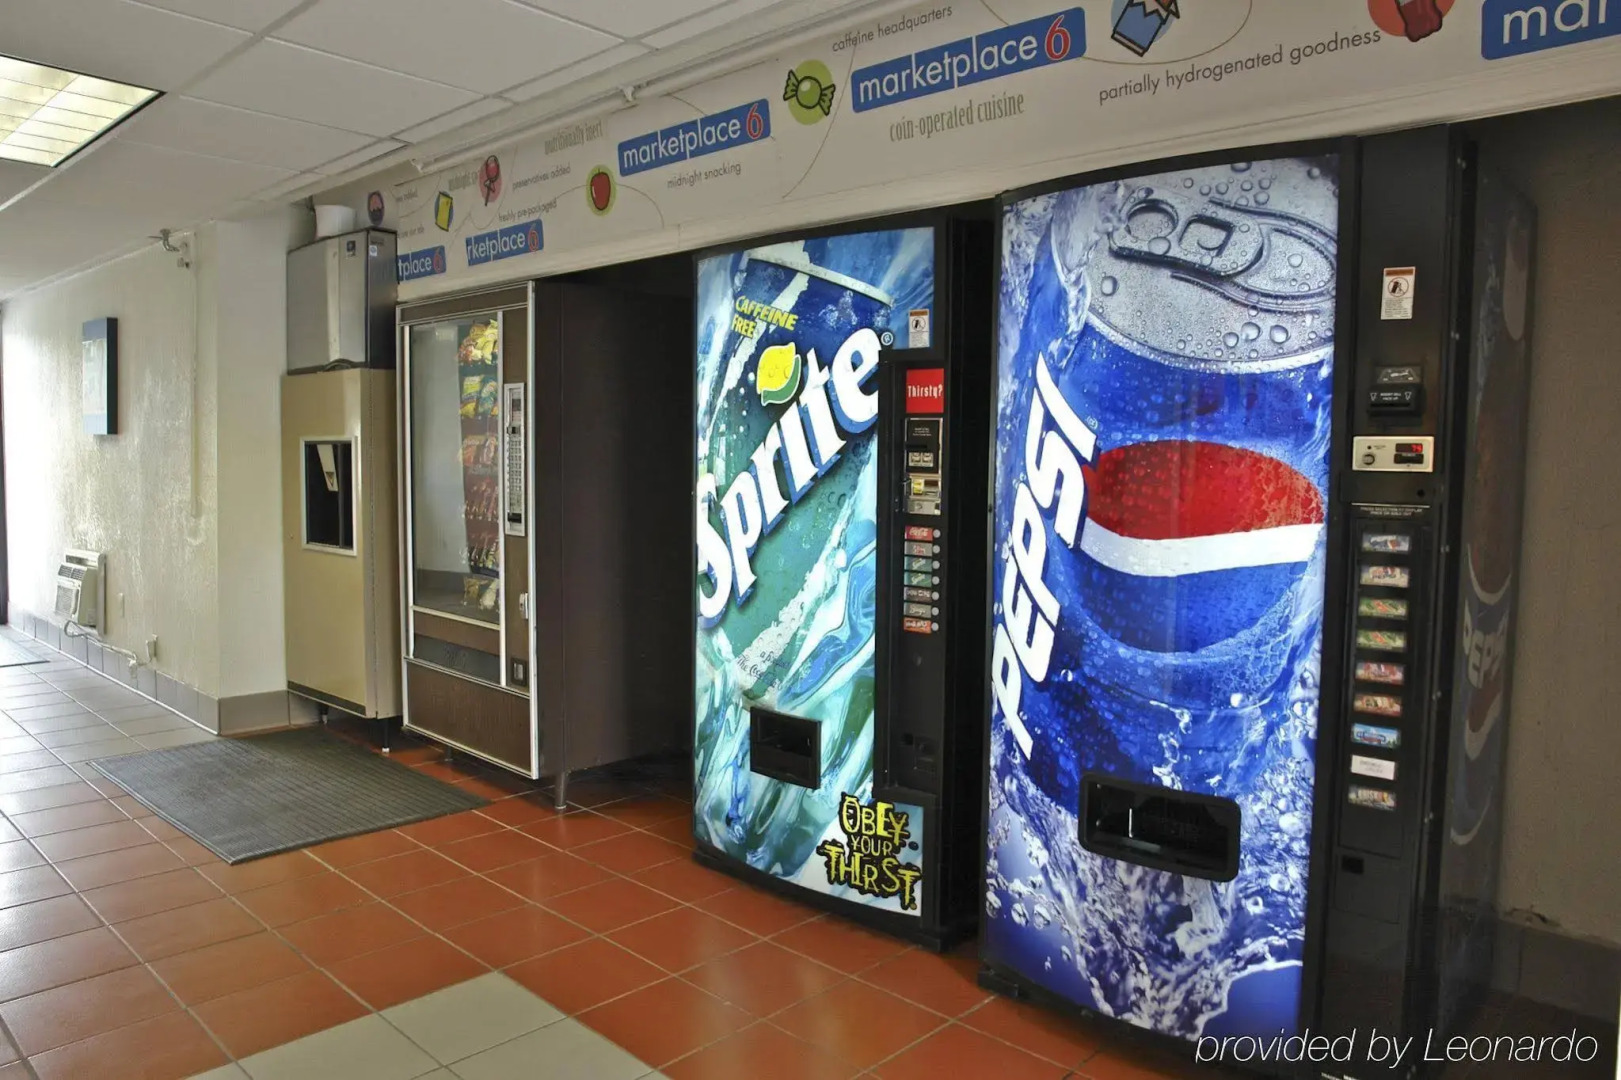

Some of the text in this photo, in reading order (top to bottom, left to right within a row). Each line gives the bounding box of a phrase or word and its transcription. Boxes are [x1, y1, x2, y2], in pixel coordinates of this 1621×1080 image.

[832, 5, 953, 52] caffeine headquarters
[859, 14, 1072, 104] marketplace 6
[1099, 28, 1381, 105] partially hydrogenated goodness
[624, 103, 763, 168] marketplace 6
[889, 92, 1025, 143] coin-operated cuisine
[667, 162, 742, 189] midnight snacking
[467, 223, 539, 261] rketplace 6
[730, 314, 757, 339] FREE
[735, 295, 799, 331] CAFFEINE
[907, 383, 944, 399] Thirsty?
[697, 328, 882, 620] Sprite
[992, 350, 1098, 760] PEPSI
[842, 795, 909, 846] OBEY
[850, 834, 893, 857] YOUR
